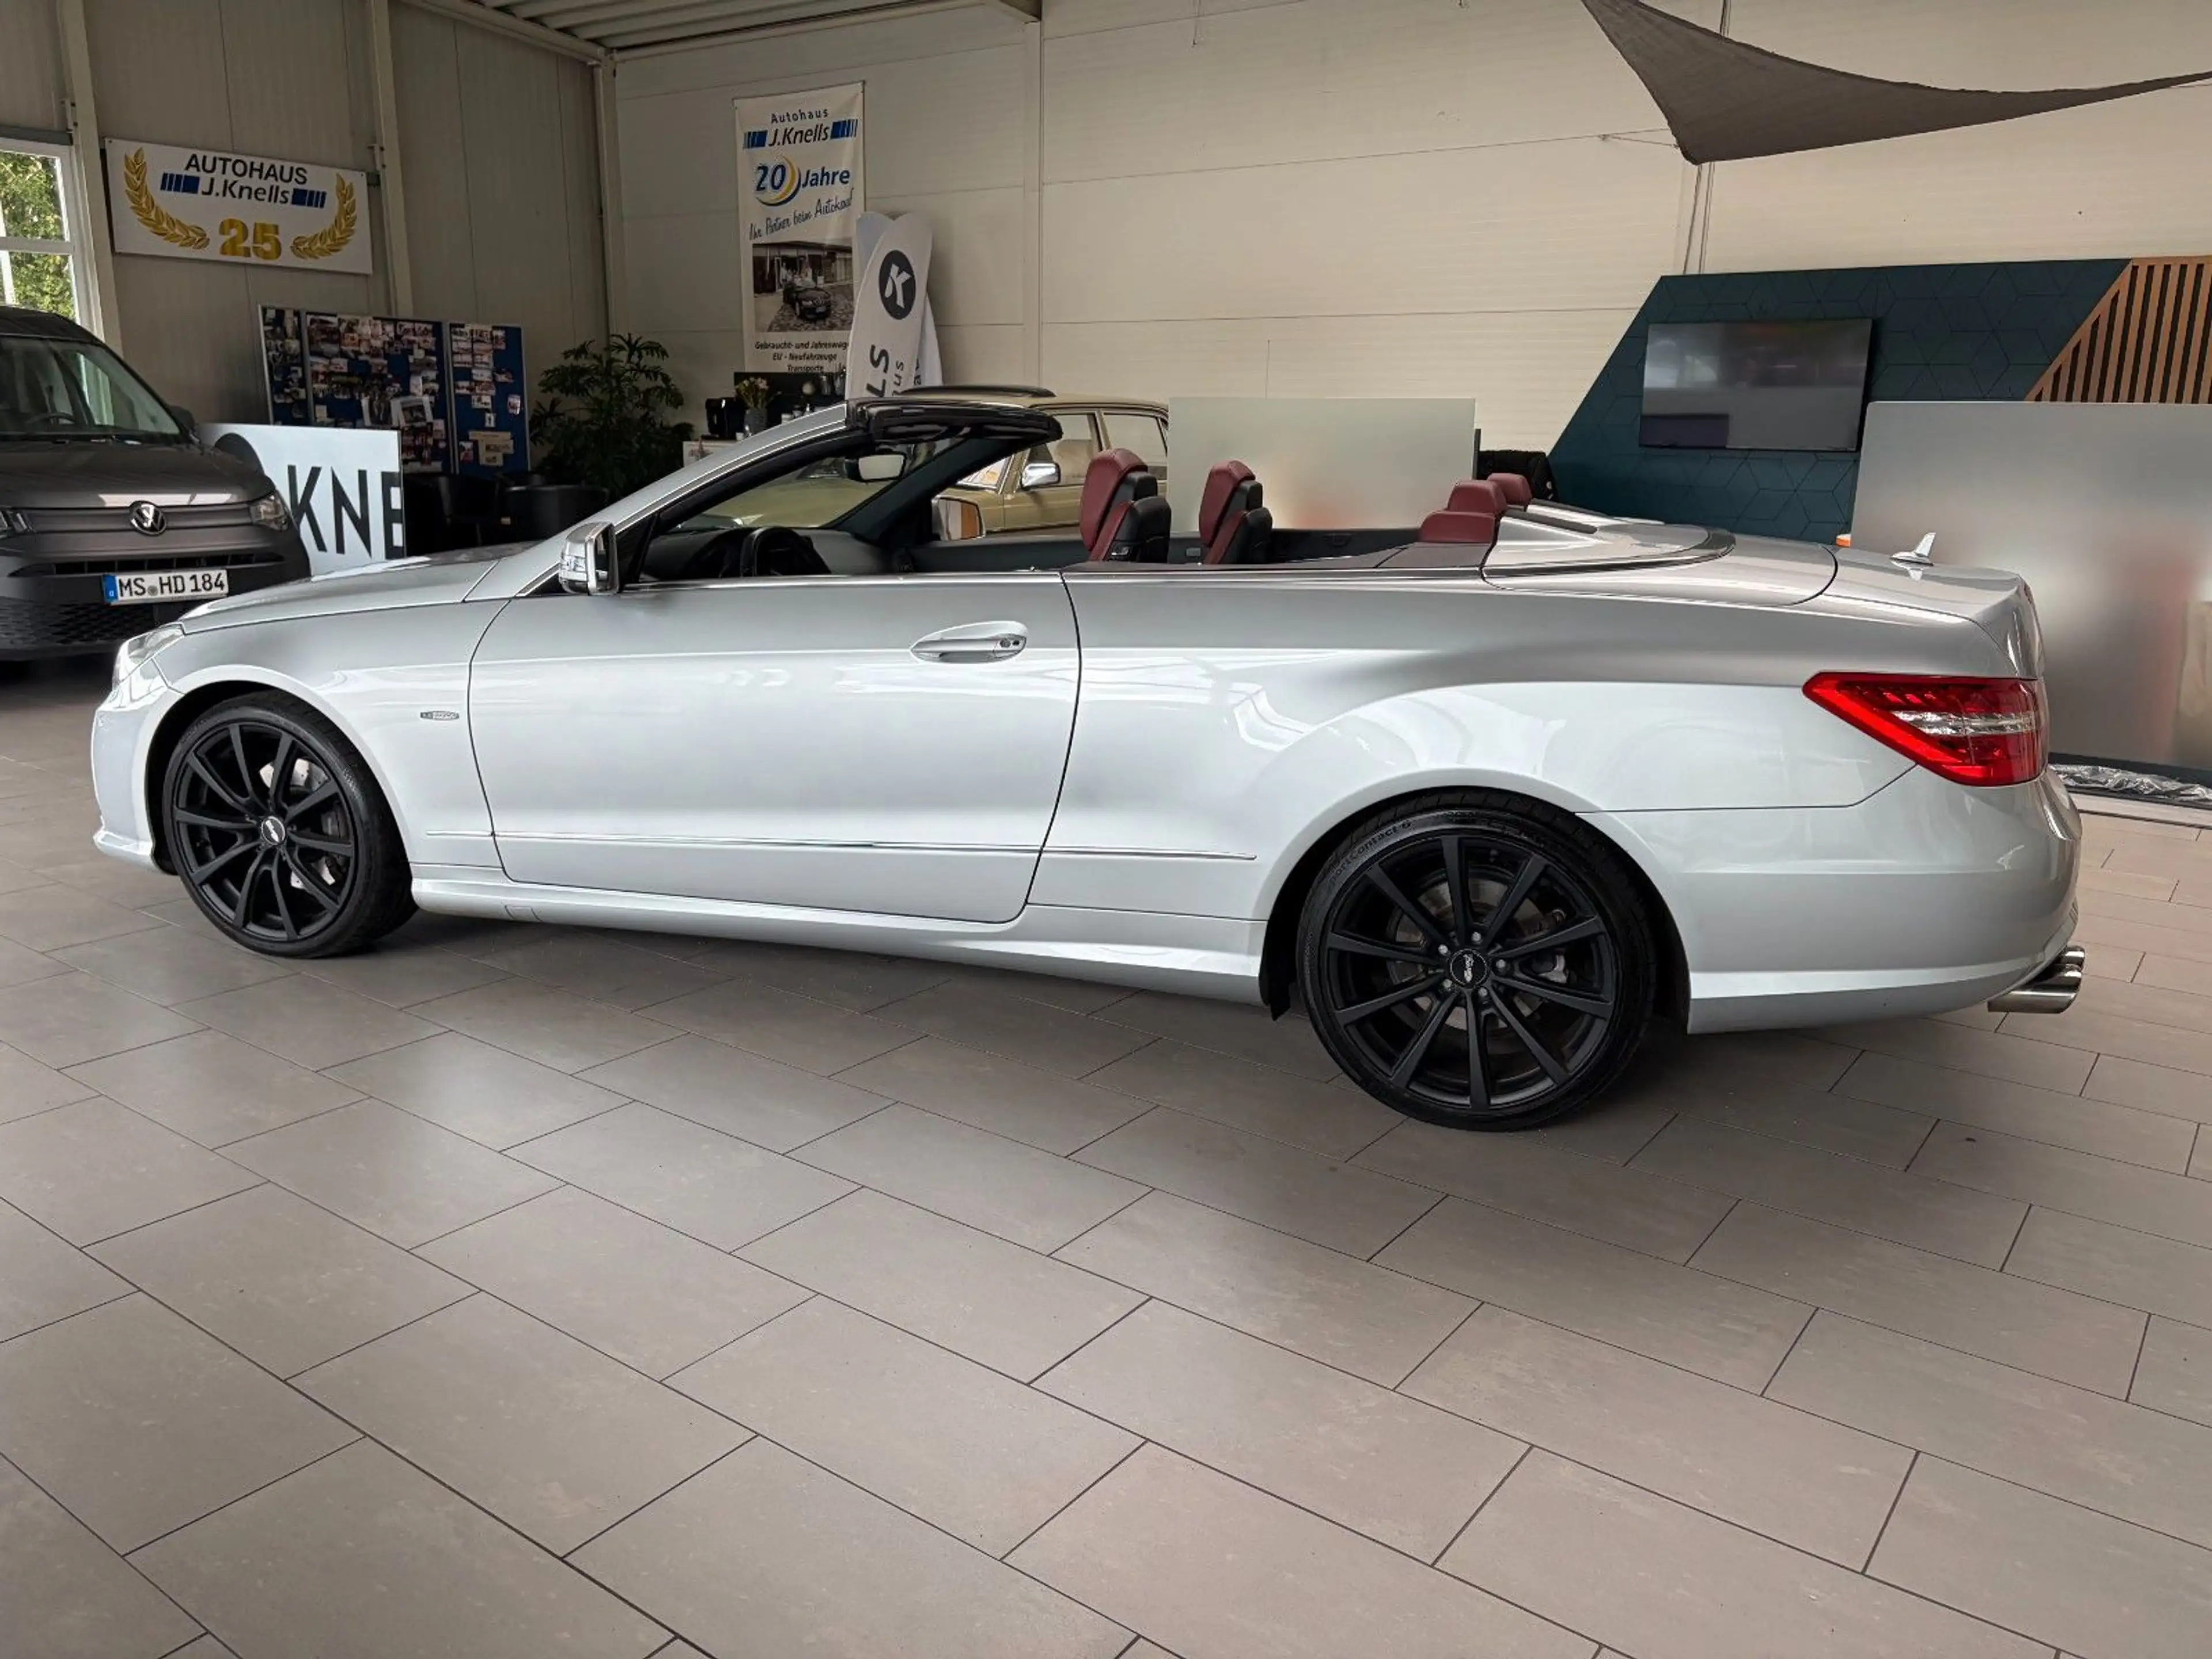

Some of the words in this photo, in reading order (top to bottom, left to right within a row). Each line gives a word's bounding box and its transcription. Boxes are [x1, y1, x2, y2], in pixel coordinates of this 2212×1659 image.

[771, 108, 829, 124] Autohaus
[768, 123, 830, 147] J.Knells
[184, 153, 308, 185] AUTOHAUS
[756, 162, 786, 191] 20
[802, 165, 850, 188] Jahre
[202, 177, 290, 204] J.Knells
[218, 218, 282, 260] 25
[772, 352, 783, 361] EU
[794, 340, 809, 349] und
[119, 577, 146, 597] MS
[159, 575, 185, 594] HD
[190, 572, 225, 593] 184
